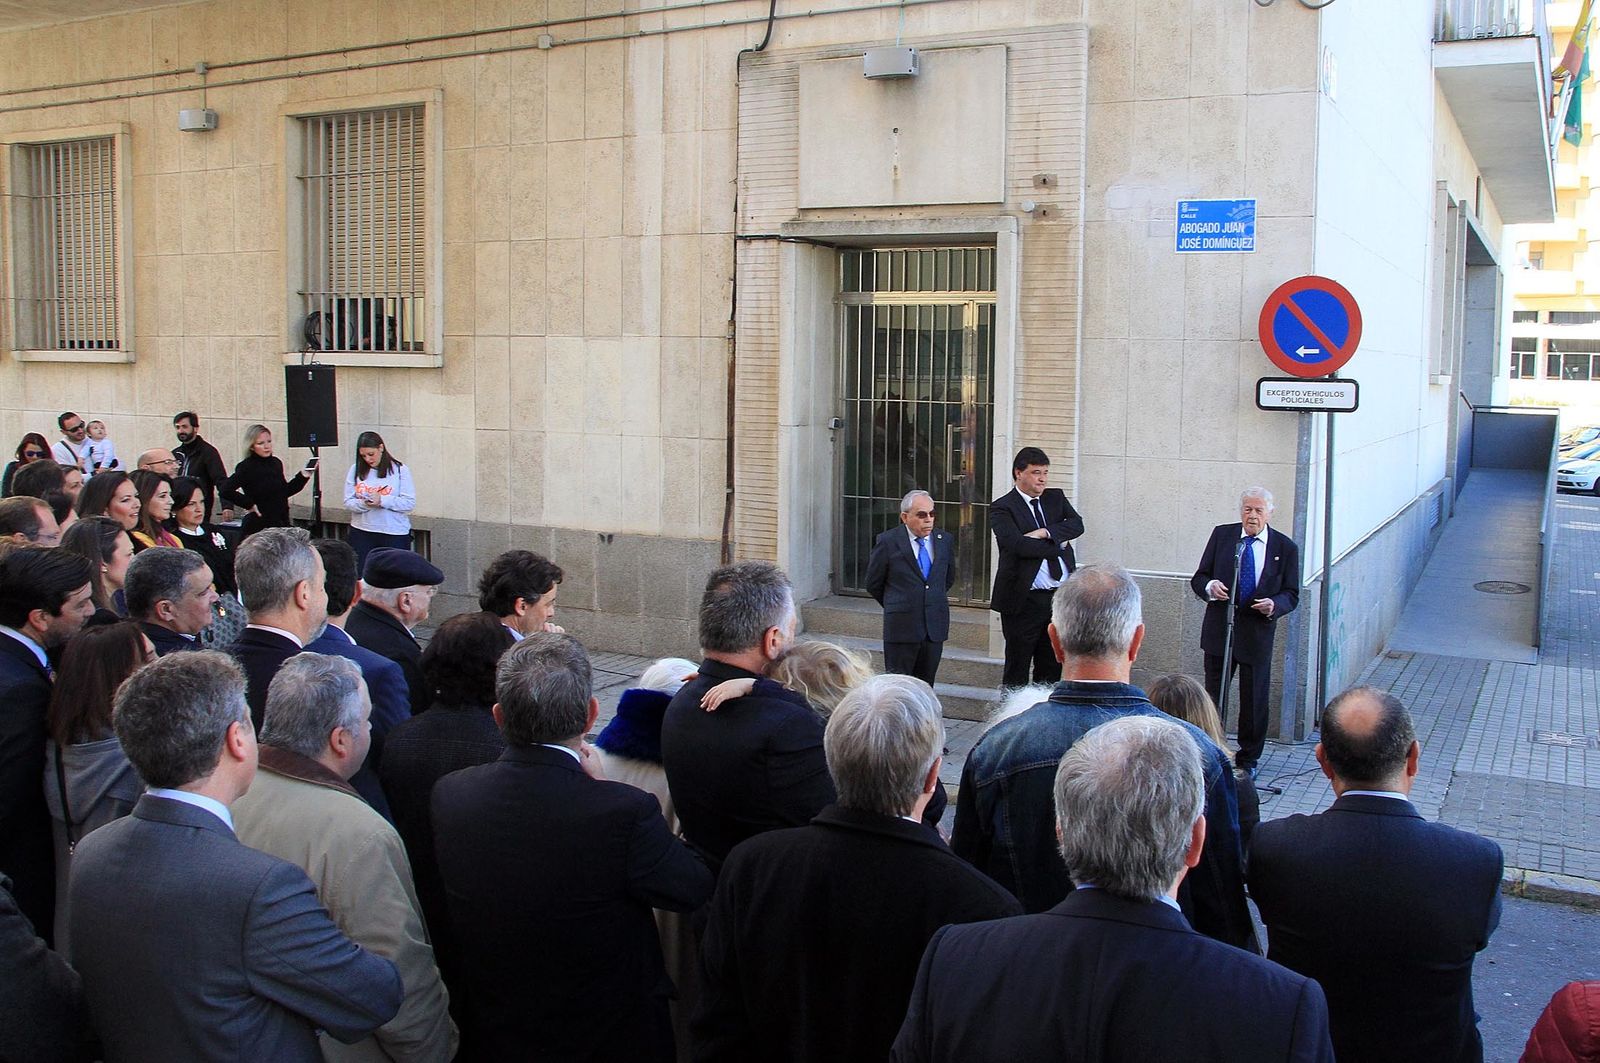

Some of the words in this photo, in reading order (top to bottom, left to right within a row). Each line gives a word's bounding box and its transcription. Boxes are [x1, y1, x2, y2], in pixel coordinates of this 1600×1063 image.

[1180, 222, 1220, 233] ABOGADO
[1222, 222, 1244, 233] JUAN
[1179, 236, 1200, 248] JOSÉ
[1203, 236, 1252, 248] DOMÍNGUEZ
